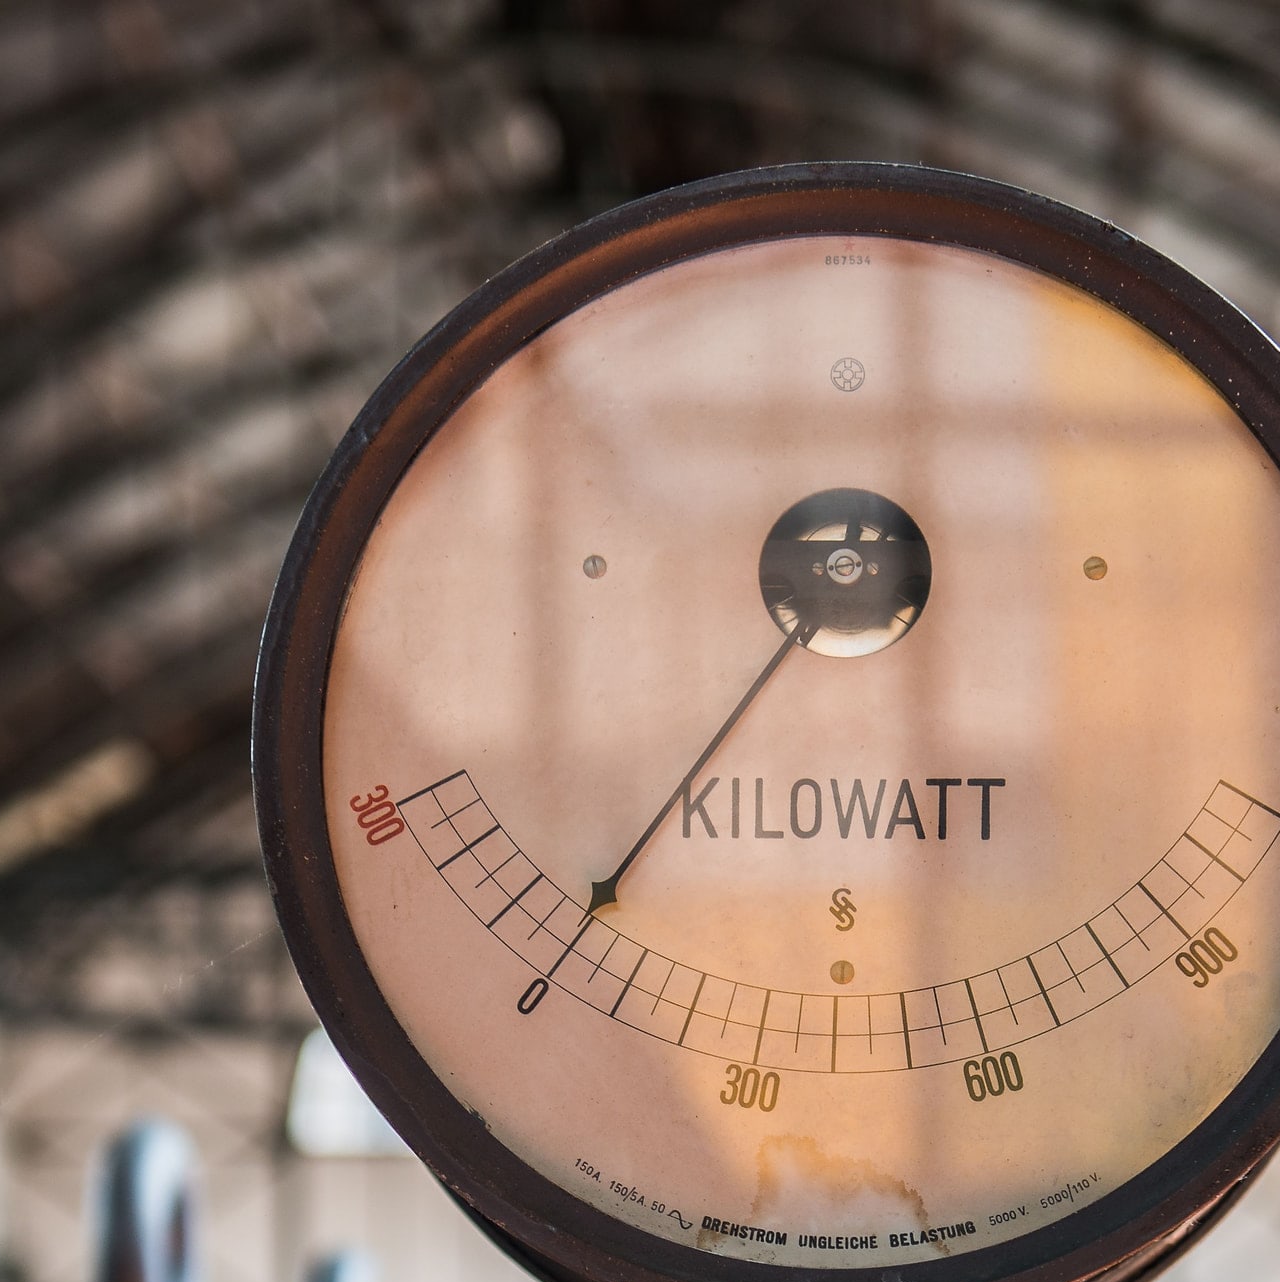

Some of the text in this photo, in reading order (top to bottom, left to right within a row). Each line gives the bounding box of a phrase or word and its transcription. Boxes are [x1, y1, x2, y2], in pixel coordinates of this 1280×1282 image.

[349, 784, 405, 847] 300
[683, 777, 1007, 841] KILOWATT
[1176, 927, 1239, 989] 900
[516, 977, 550, 1015] 0
[719, 1064, 781, 1113] 300
[963, 1051, 1024, 1103] 600
[651, 1201, 665, 1213] 50
[701, 1215, 788, 1246] DREHSTROM
[799, 1235, 878, 1249] UNGLEICHE
[889, 1220, 977, 1248] BELASTUNG
